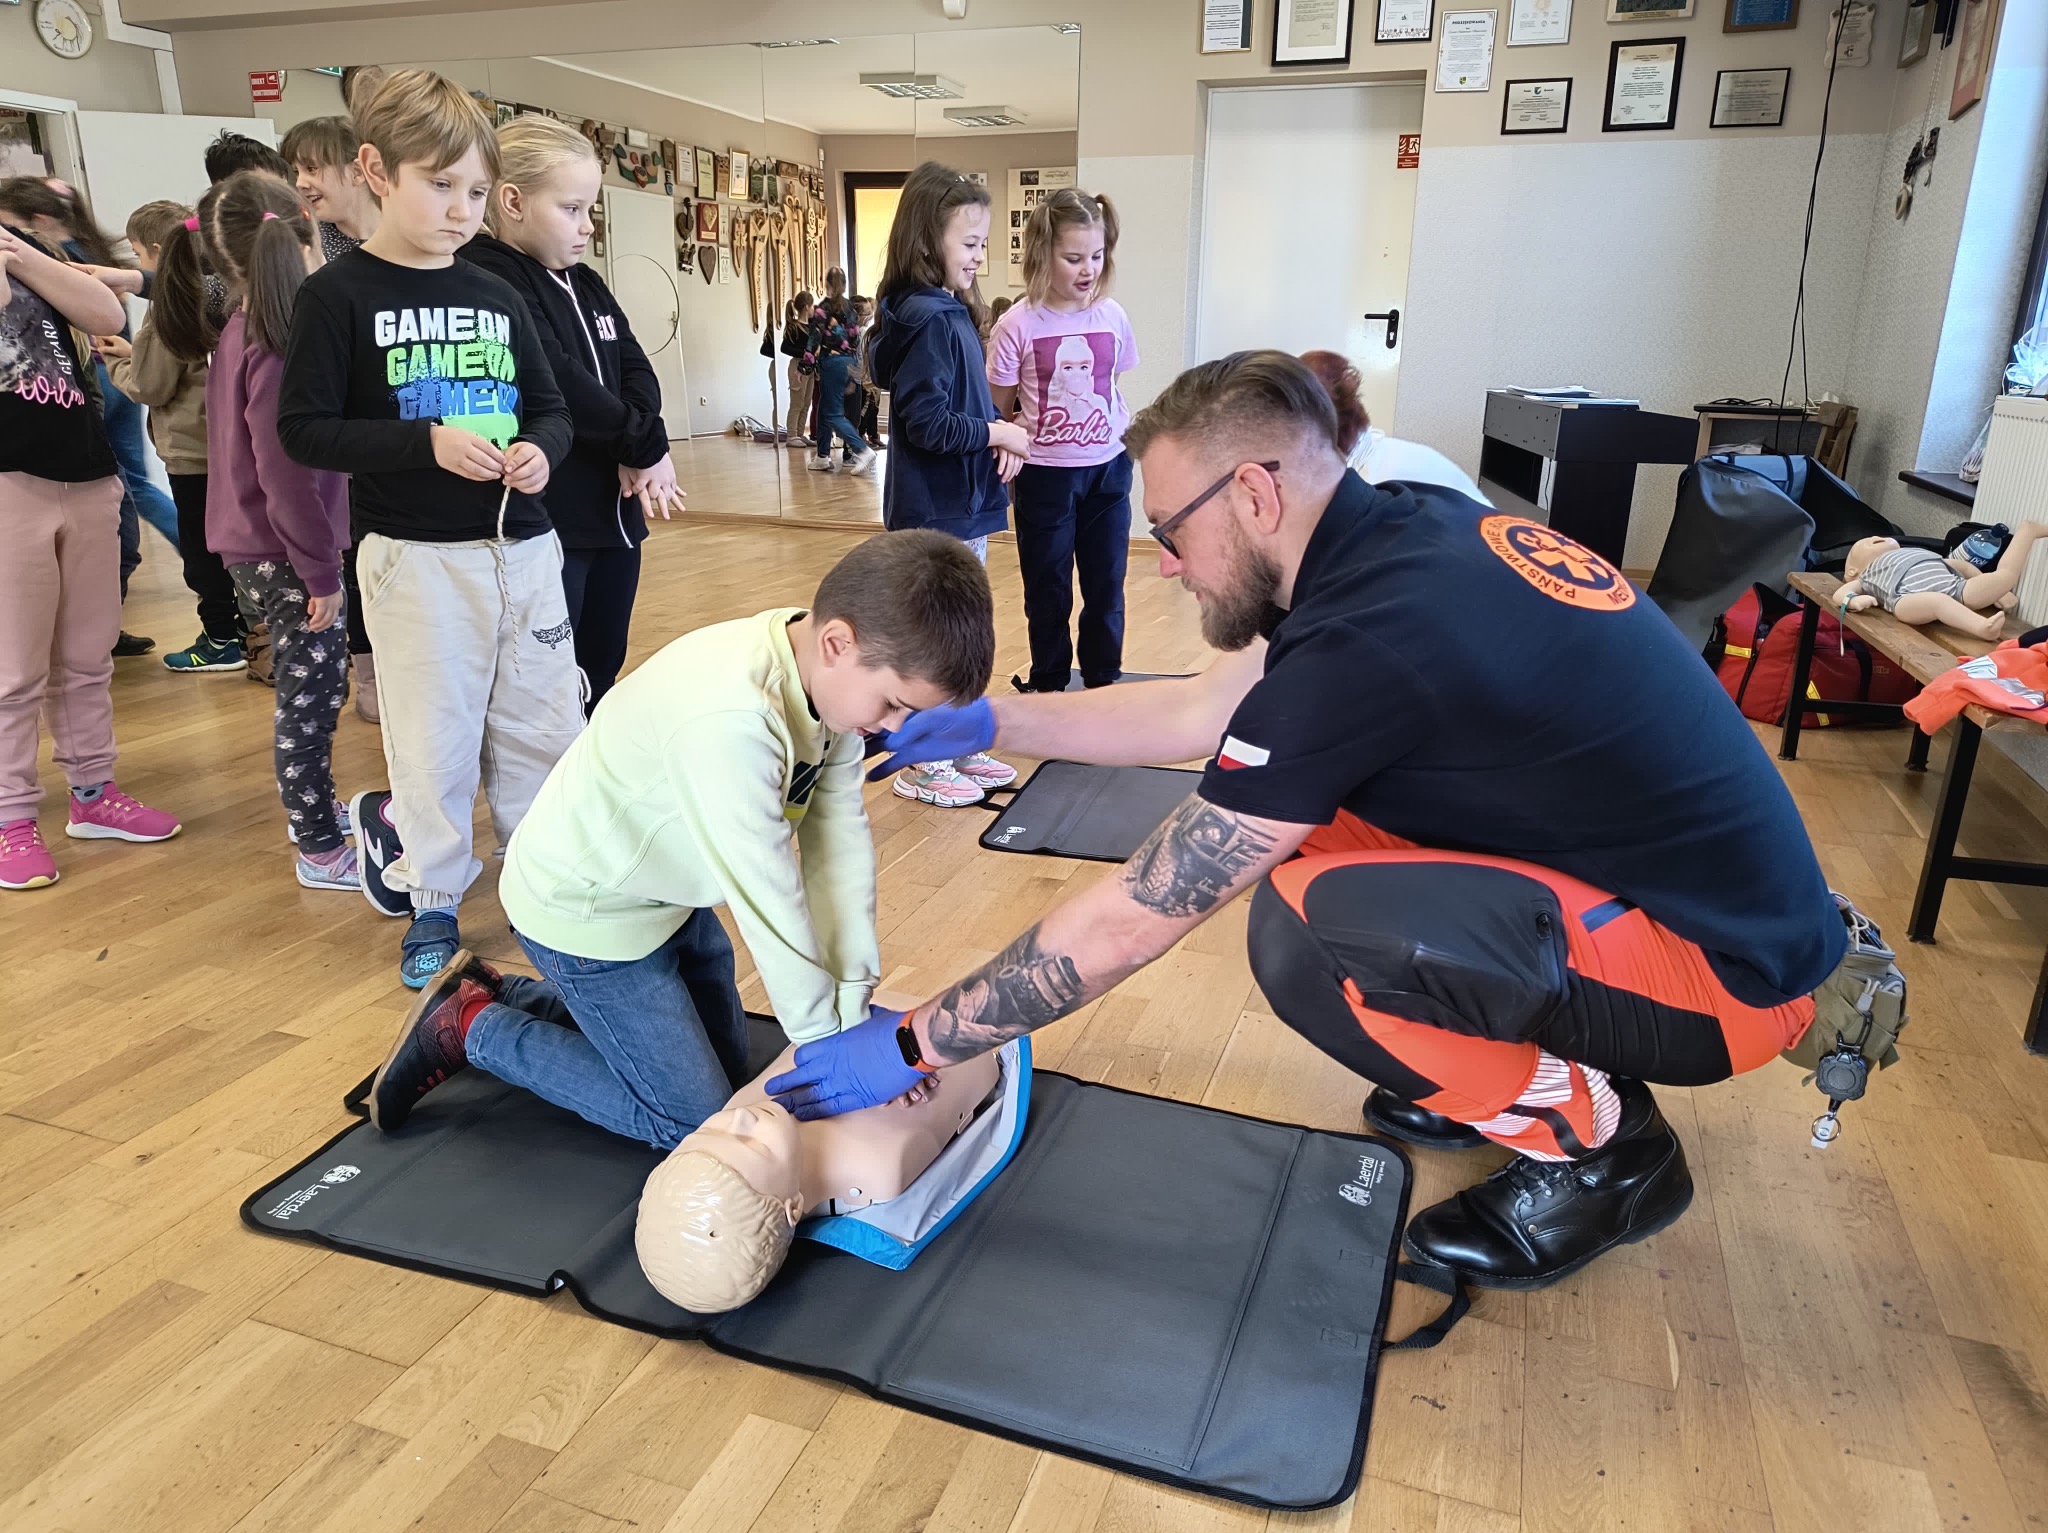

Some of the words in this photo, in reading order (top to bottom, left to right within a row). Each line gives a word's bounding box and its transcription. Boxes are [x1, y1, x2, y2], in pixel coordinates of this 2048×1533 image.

[41, 319, 72, 375] GEPARD
[1034, 406, 1112, 447] Barbie
[1353, 1154, 1375, 1187] Laerdal
[275, 1184, 330, 1220] Laerdal
